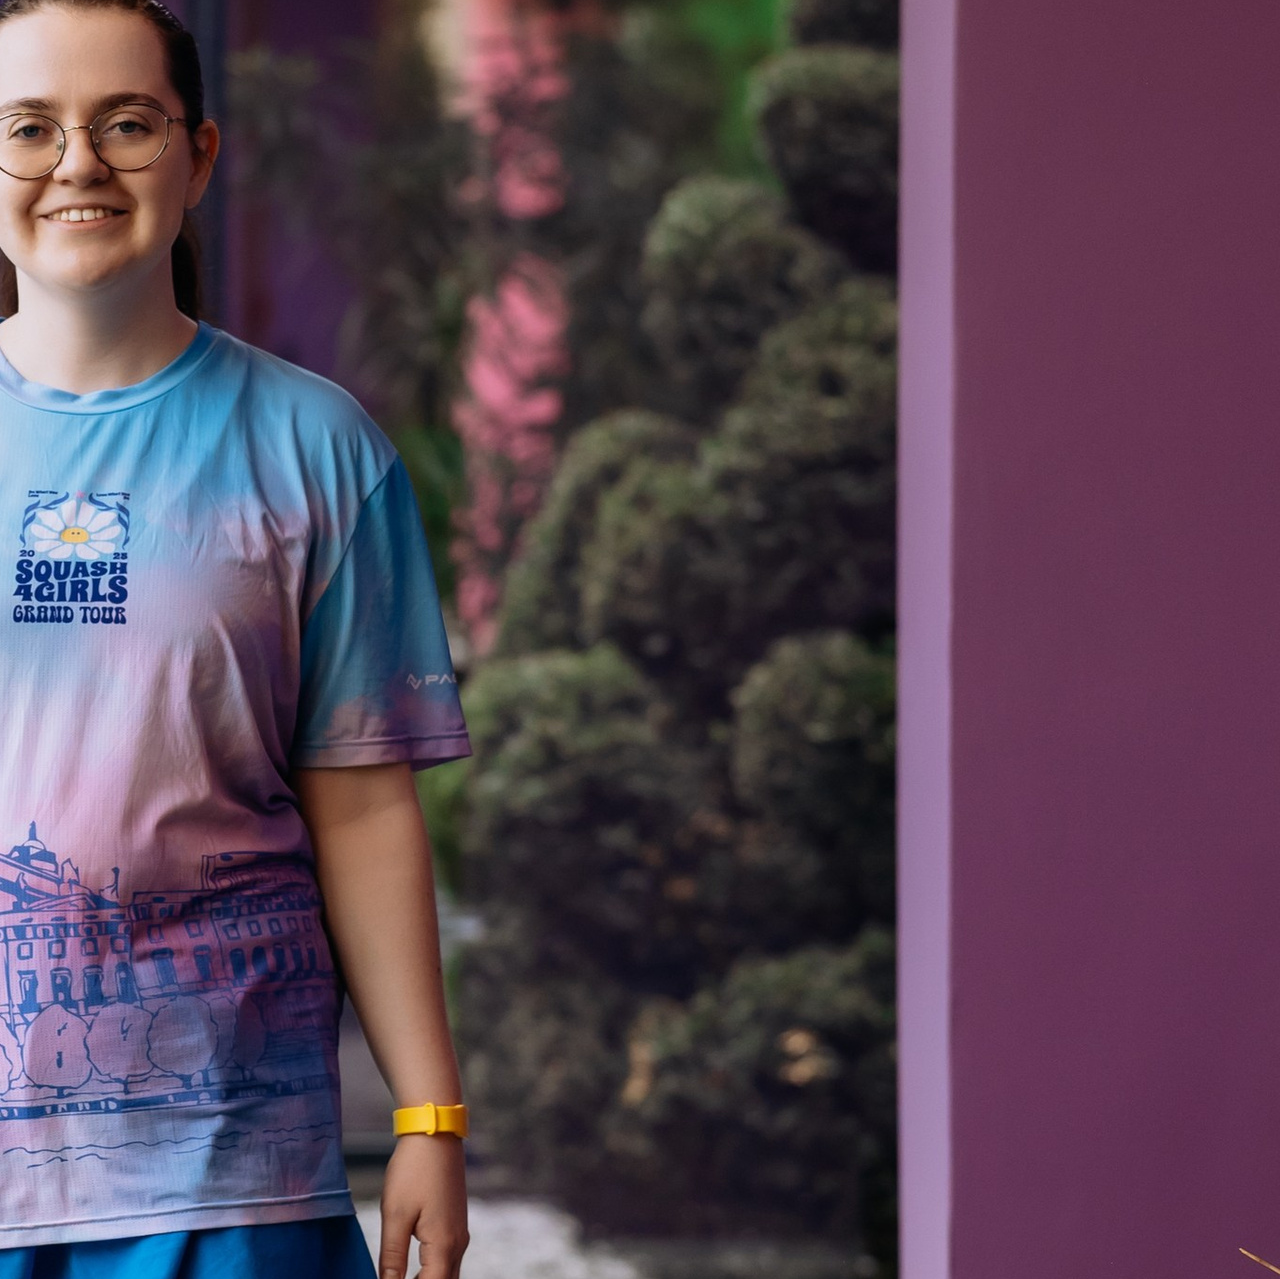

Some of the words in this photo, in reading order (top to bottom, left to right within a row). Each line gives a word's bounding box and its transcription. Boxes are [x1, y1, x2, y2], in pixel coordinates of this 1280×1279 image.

[15, 559, 128, 584] SQUASH
[13, 575, 128, 604] 4GIRLS
[13, 605, 74, 623] GRAND
[79, 606, 127, 624] TOUR
